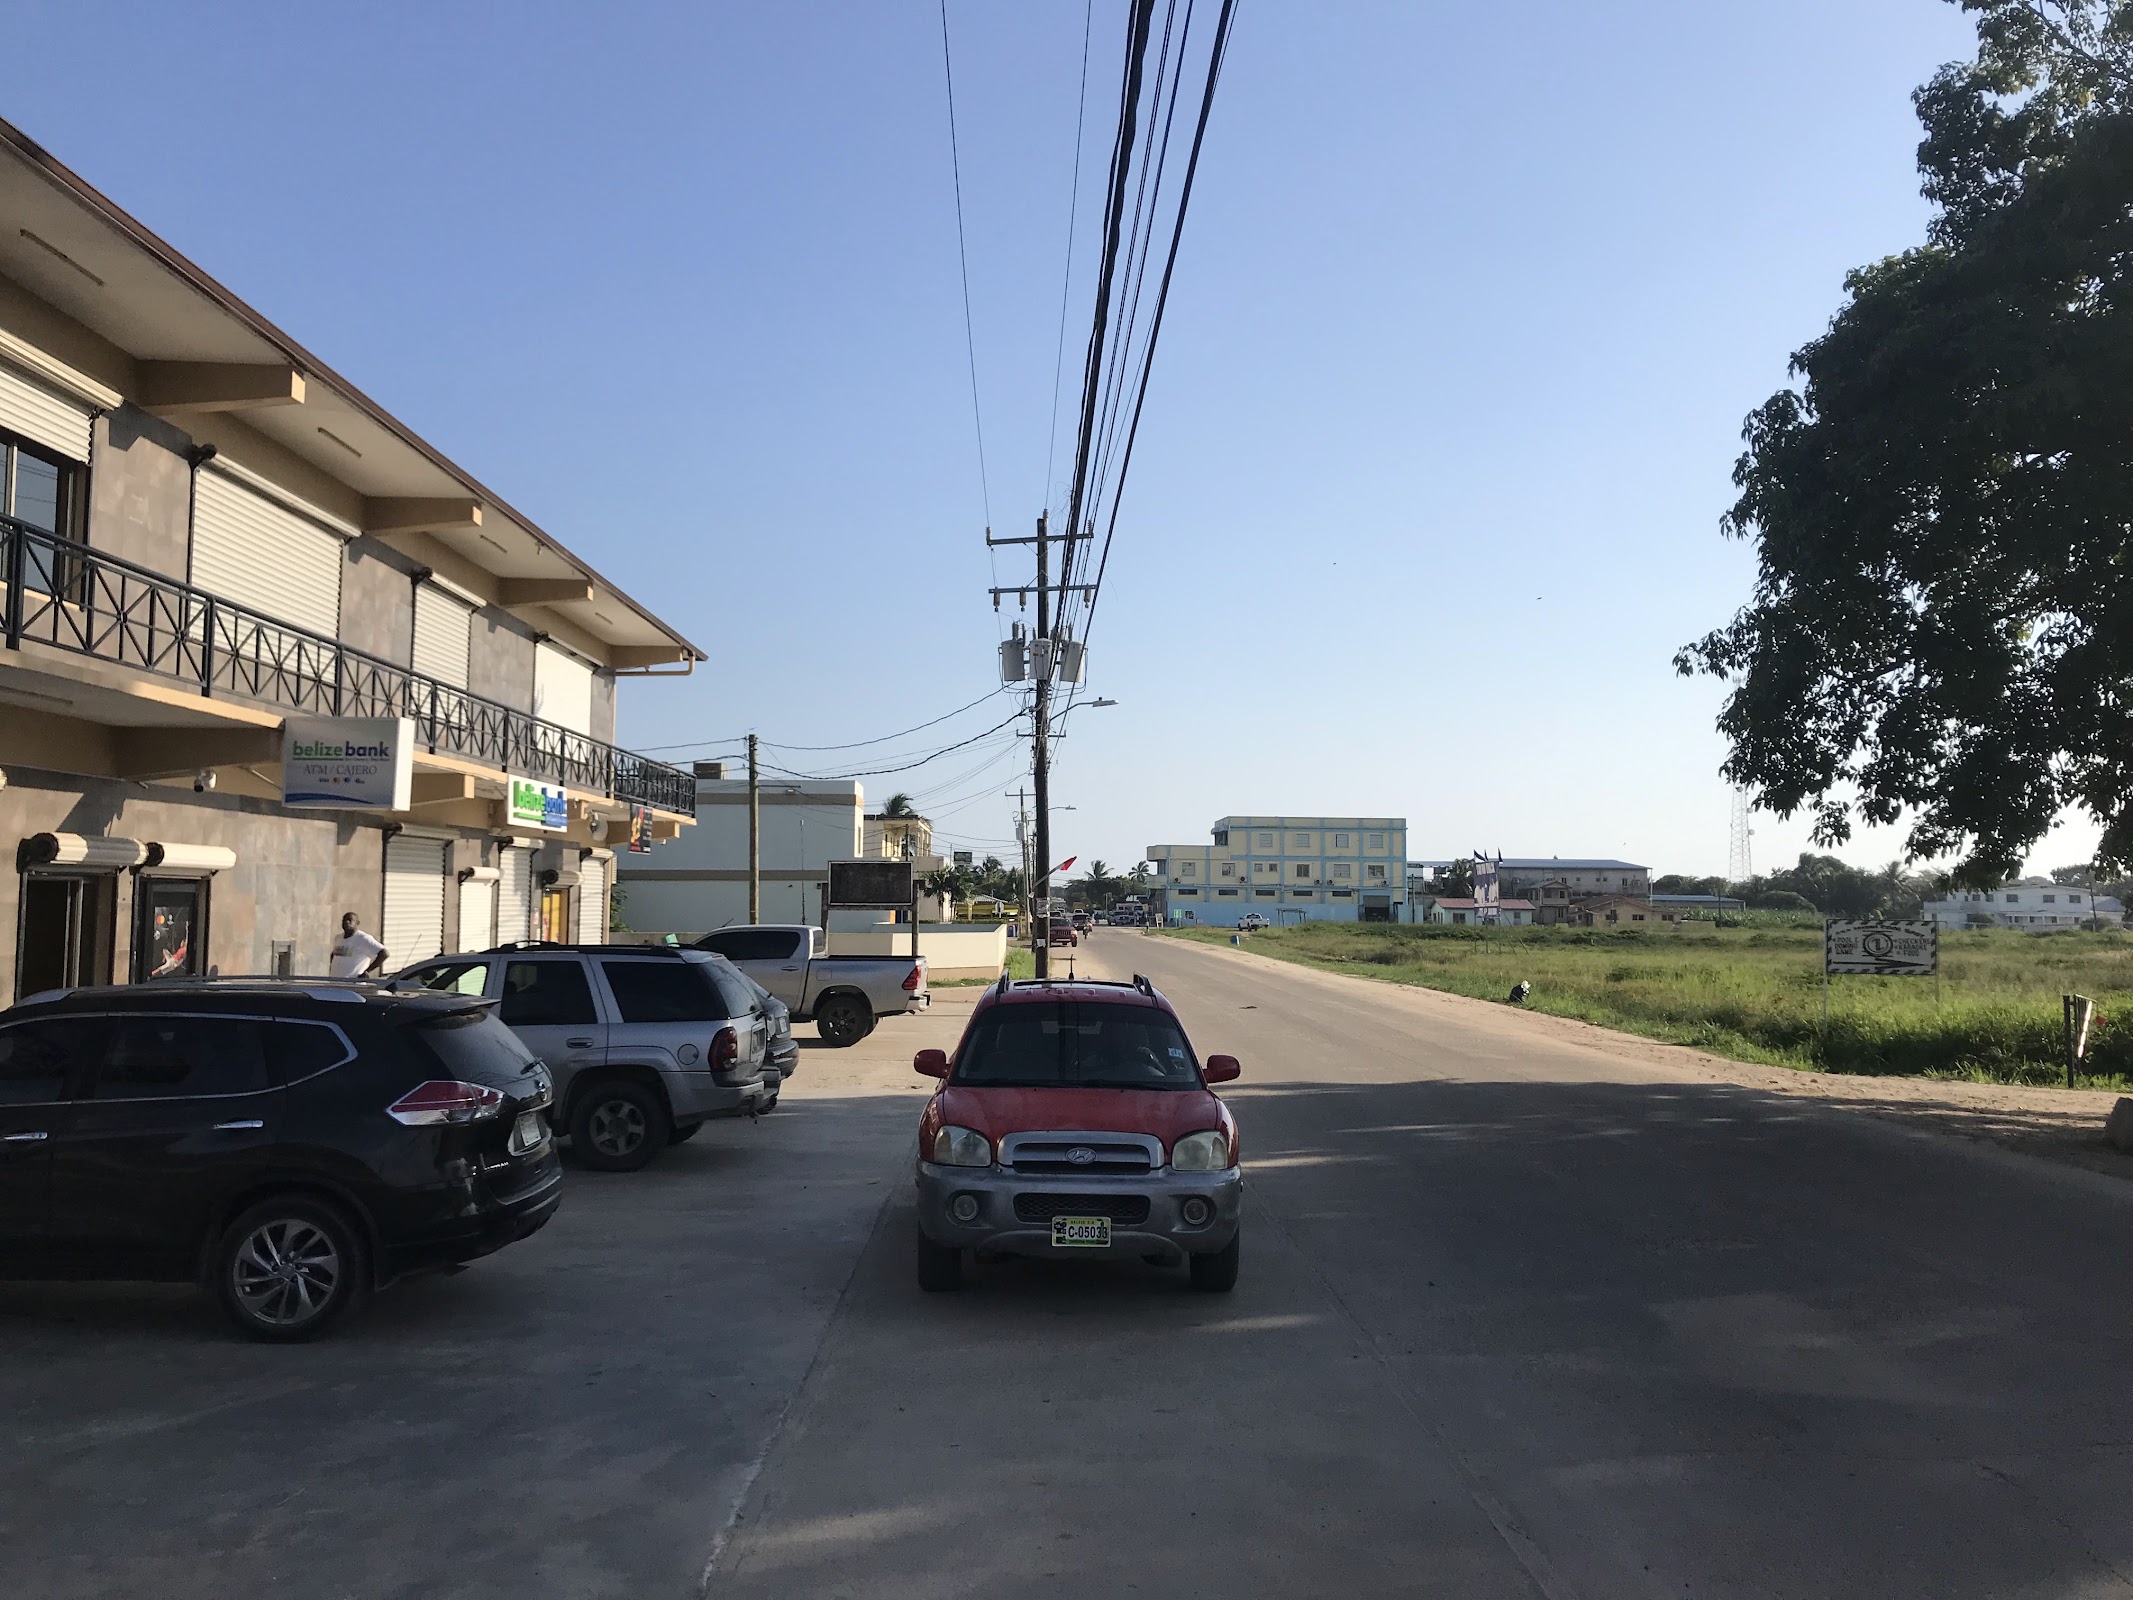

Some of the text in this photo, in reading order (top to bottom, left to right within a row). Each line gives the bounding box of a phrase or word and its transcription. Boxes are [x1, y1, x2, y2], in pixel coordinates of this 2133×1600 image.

[293, 741, 389, 757] belize bank
[303, 764, 328, 774] ATM
[336, 764, 377, 775] CAJERO
